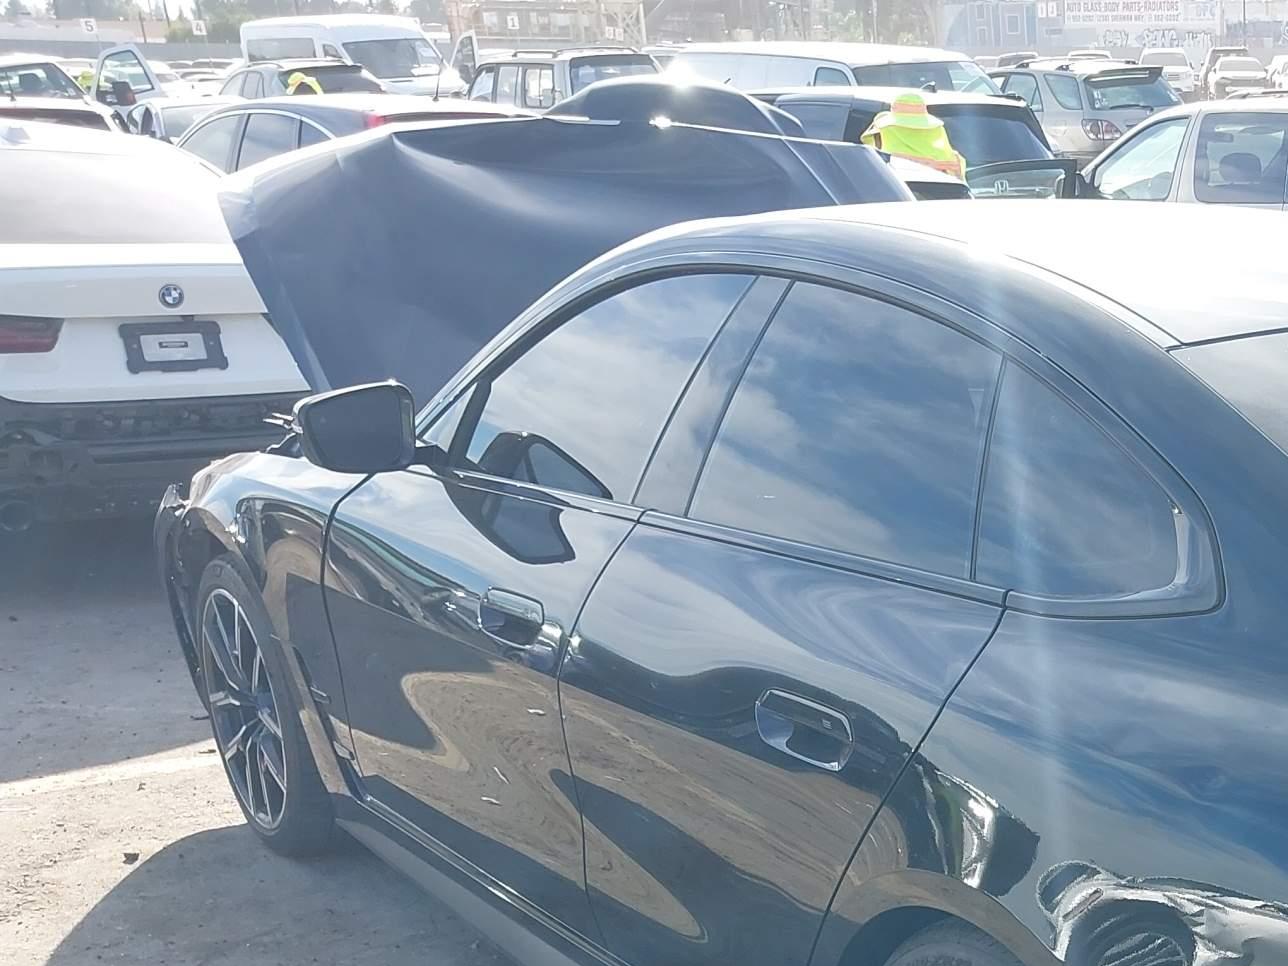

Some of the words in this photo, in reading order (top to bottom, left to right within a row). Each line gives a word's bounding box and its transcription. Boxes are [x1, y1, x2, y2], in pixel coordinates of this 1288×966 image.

[1066, 1, 1081, 12] AUTO
[84, 20, 94, 33] 5
[195, 22, 203, 33] 4
